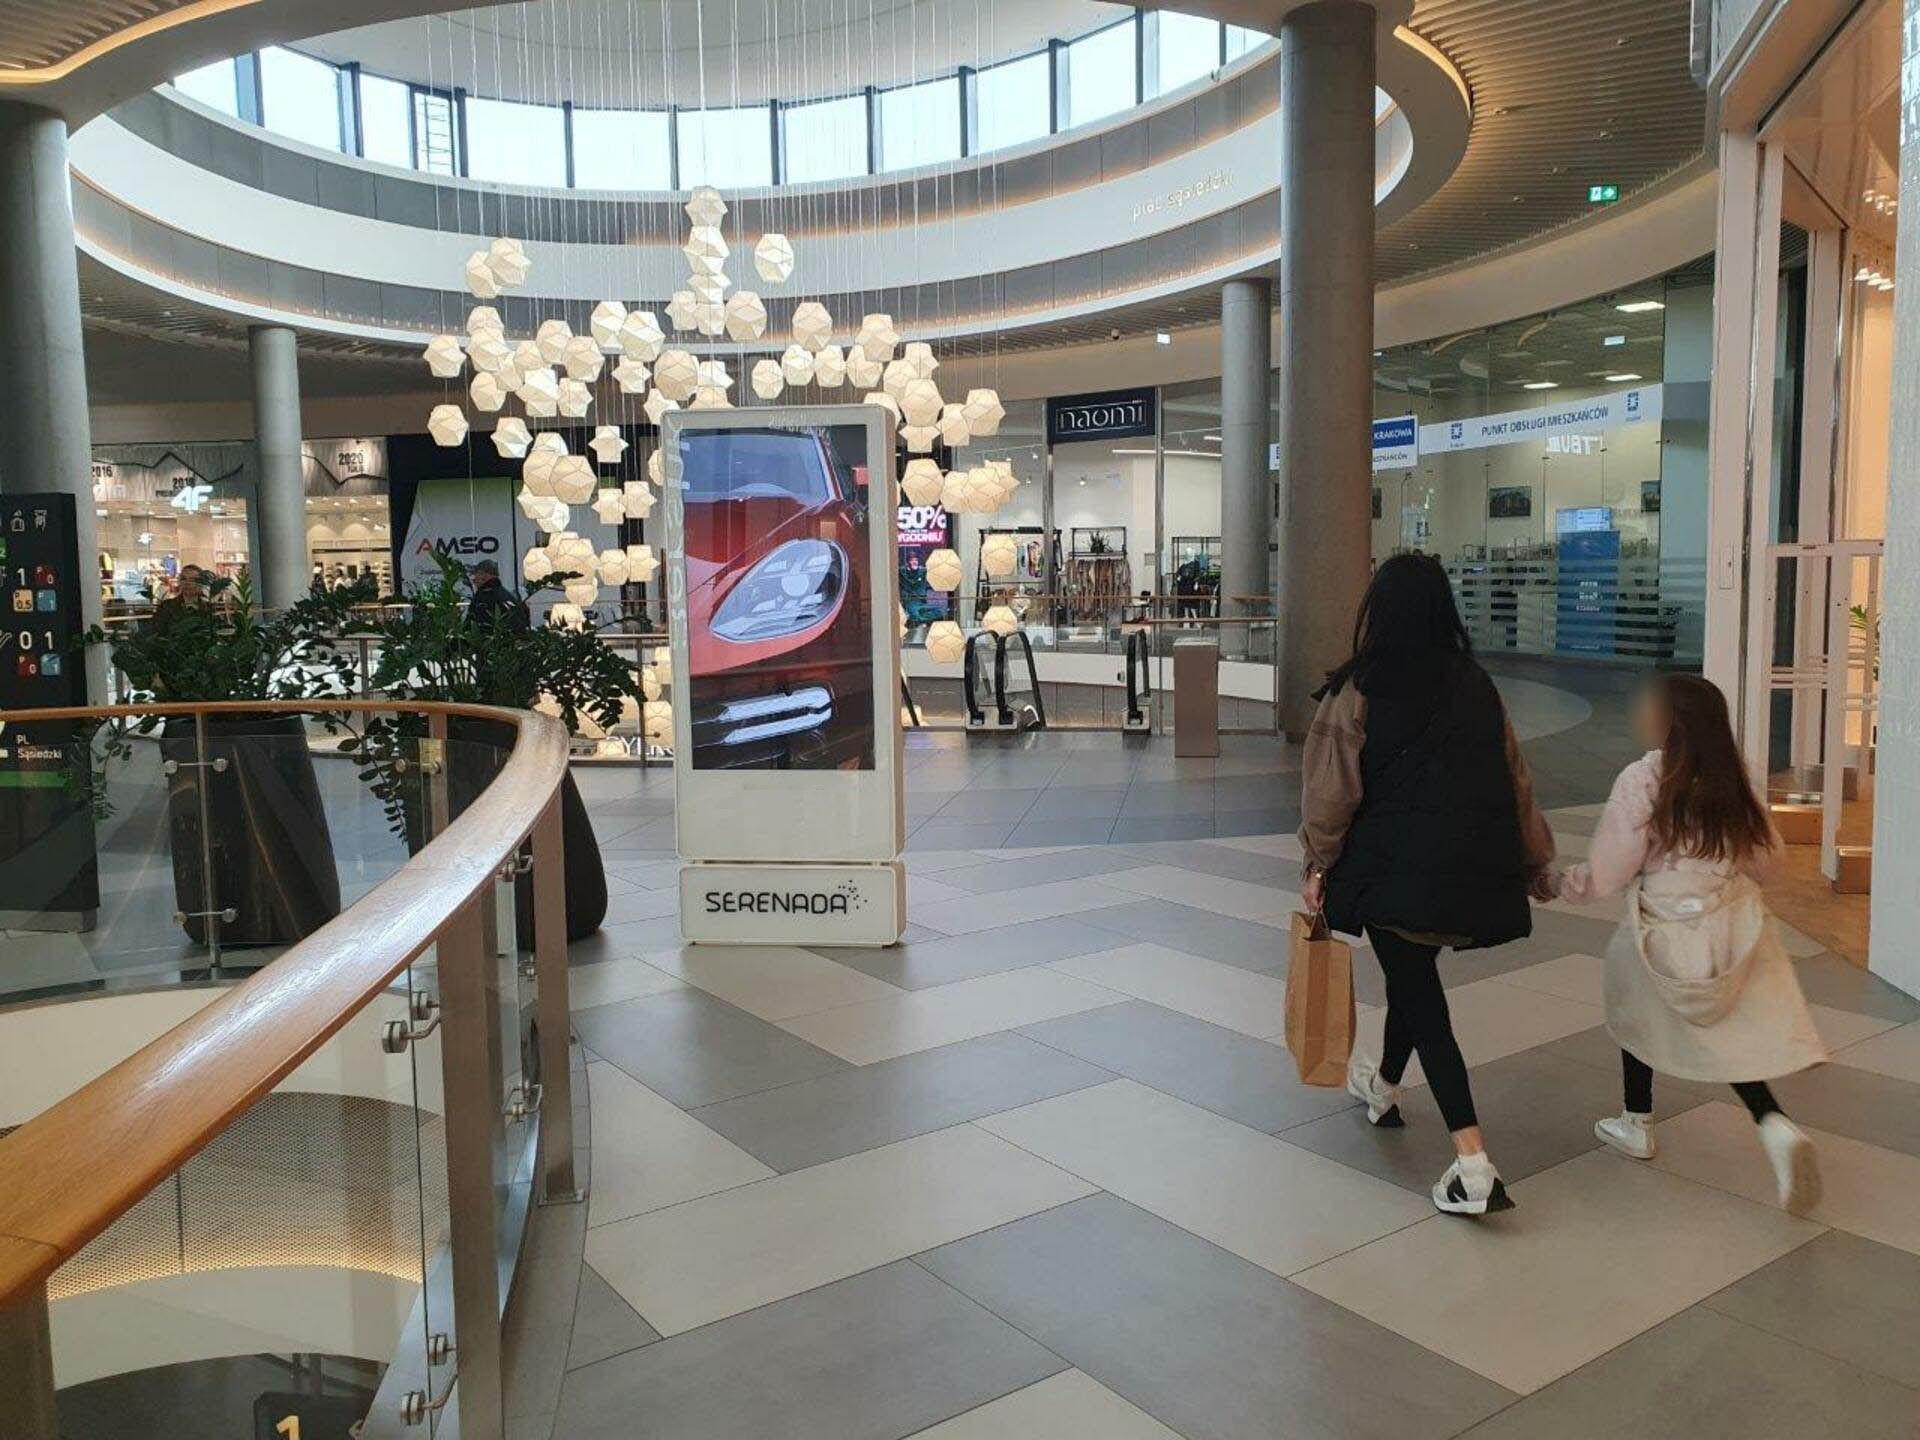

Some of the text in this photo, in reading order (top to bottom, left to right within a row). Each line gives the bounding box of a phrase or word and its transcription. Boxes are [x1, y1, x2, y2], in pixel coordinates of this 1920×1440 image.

[1060, 405, 1142, 429] naomi
[1481, 422, 1508, 436] PUNKT
[1510, 416, 1546, 433] OBSŁUGI
[1373, 428, 1413, 441] KRAKOWA
[170, 485, 214, 511] 4F
[416, 536, 499, 555] AMSO
[17, 567, 26, 586] 1
[20, 631, 53, 650] 0 1
[705, 892, 847, 915] SERENADA
[276, 1415, 300, 1440] 1
